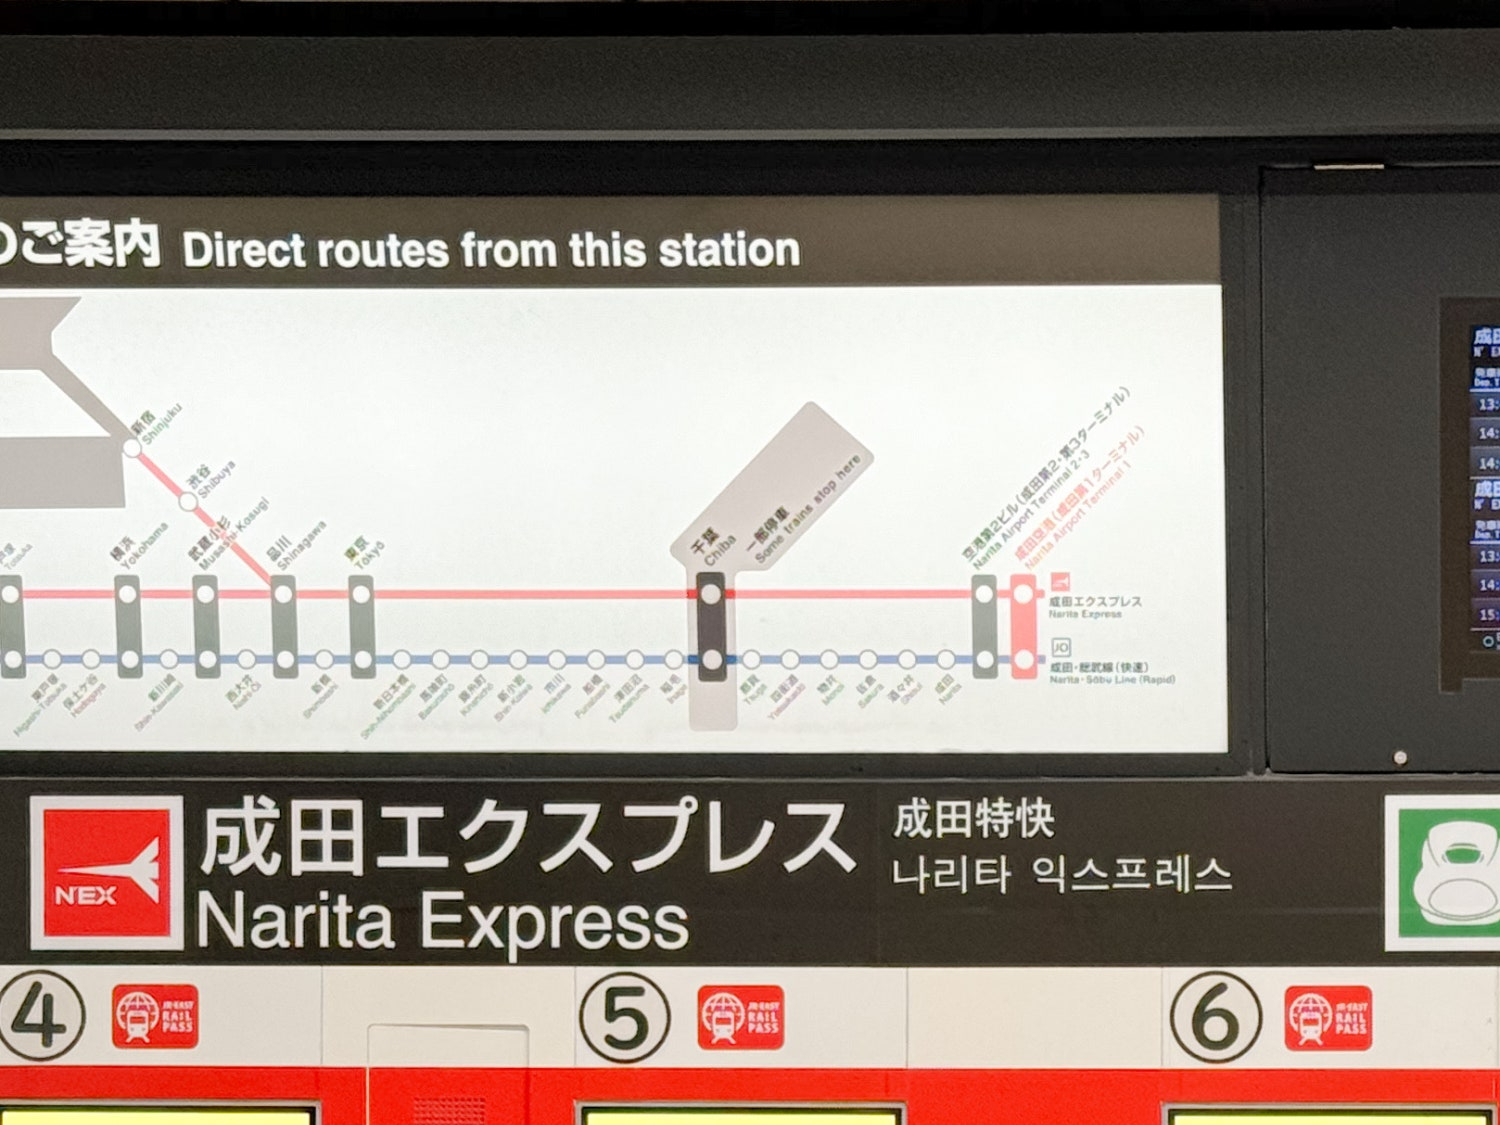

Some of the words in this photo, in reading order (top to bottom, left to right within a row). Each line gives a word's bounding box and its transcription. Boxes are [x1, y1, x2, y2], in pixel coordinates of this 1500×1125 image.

[183, 231, 307, 267] Direct
[318, 232, 450, 267] routes
[462, 231, 557, 266] from
[569, 229, 648, 266] this
[659, 230, 801, 267] station
[141, 402, 183, 446] Shinjuku
[197, 460, 236, 500] Shibuya
[1084, 470, 1126, 510] Terminal
[754, 534, 785, 565] Some
[783, 504, 814, 536] trains
[812, 478, 838, 505] stop
[835, 454, 862, 482] here
[1001, 507, 1036, 544] Airport
[1032, 467, 1074, 510] Terminal
[120, 521, 169, 571] Yokohama
[276, 520, 328, 571] Shinagawa
[703, 534, 737, 568] Chiba
[1049, 596, 1143, 608] 成田エクスプレス
[200, 796, 857, 876] 成田エクスプレス
[894, 797, 1056, 839] 成田特快
[892, 855, 1012, 894] 나리타
[1032, 854, 1233, 894] 익스프레스
[198, 889, 396, 949] Narita
[421, 890, 690, 963] Express
[162, 1010, 193, 1022] RAIL
[162, 1022, 194, 1033] PASS
[748, 1012, 779, 1023] RAIL
[748, 1022, 780, 1034] PASS
[1335, 1012, 1368, 1024] RAIL
[1335, 1023, 1368, 1035] PASS
